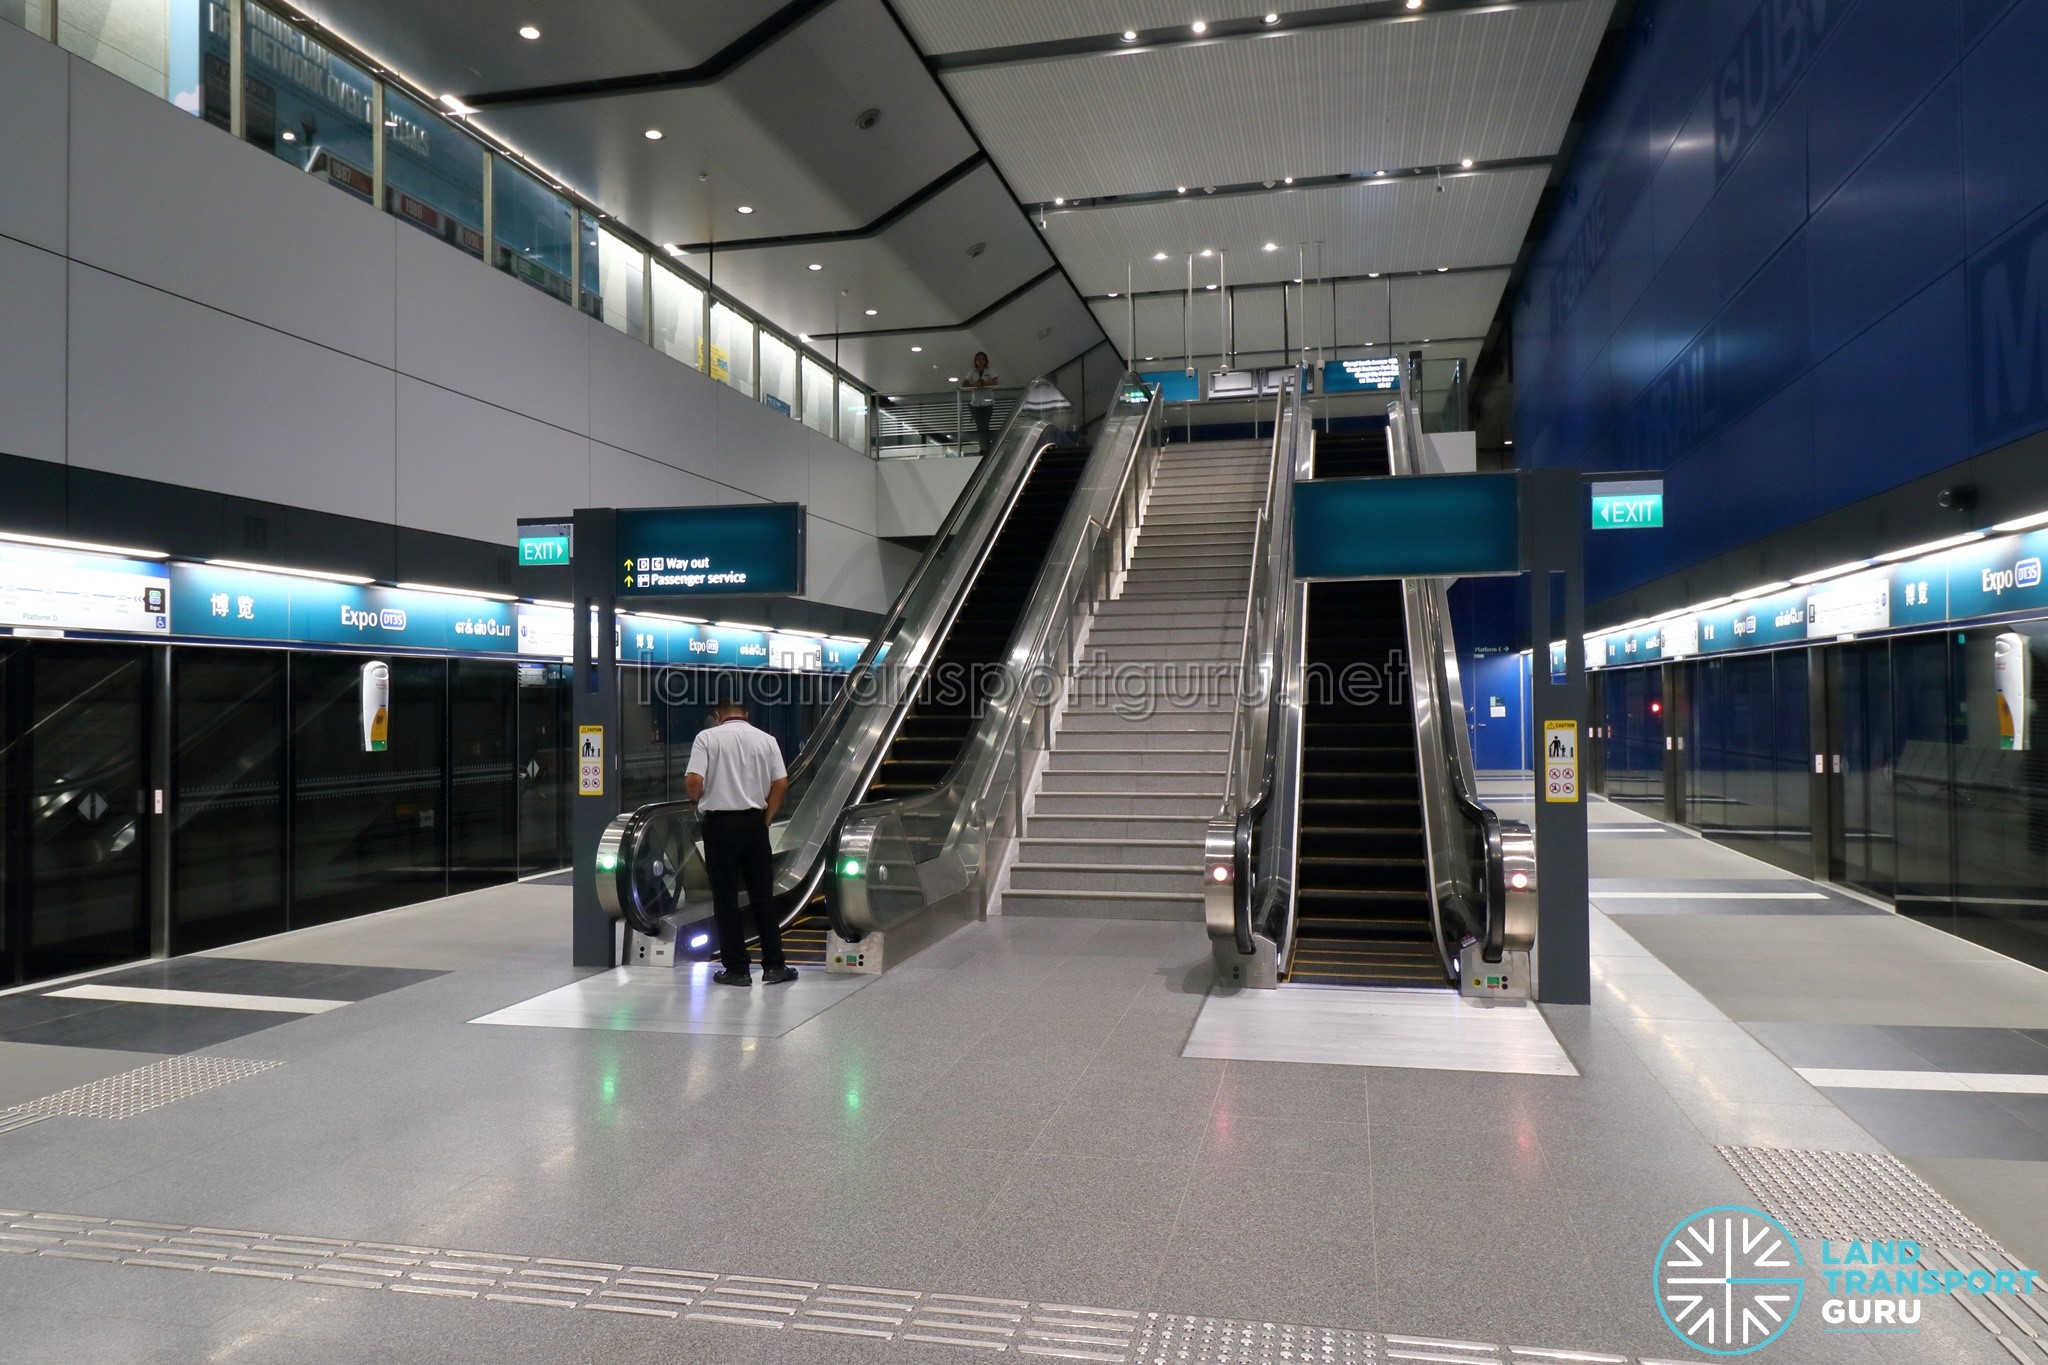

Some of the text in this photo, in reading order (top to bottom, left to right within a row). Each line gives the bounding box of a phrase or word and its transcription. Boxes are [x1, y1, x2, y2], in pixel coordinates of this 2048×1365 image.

[251, 28, 324, 97] NETWORK
[332, 161, 351, 183] 1987
[1612, 500, 1655, 523] EXIT
[524, 541, 555, 560] EXIT
[666, 557, 688, 571] Way
[690, 557, 710, 569] out
[651, 570, 747, 587] Passenger service
[1981, 564, 2038, 596] Expo DT35
[209, 592, 255, 620] 博览
[340, 604, 403, 630] Expo DT35
[454, 617, 511, 637] எக்ஸ்போ
[1733, 620, 1746, 637] Expo
[688, 638, 706, 655] Expo
